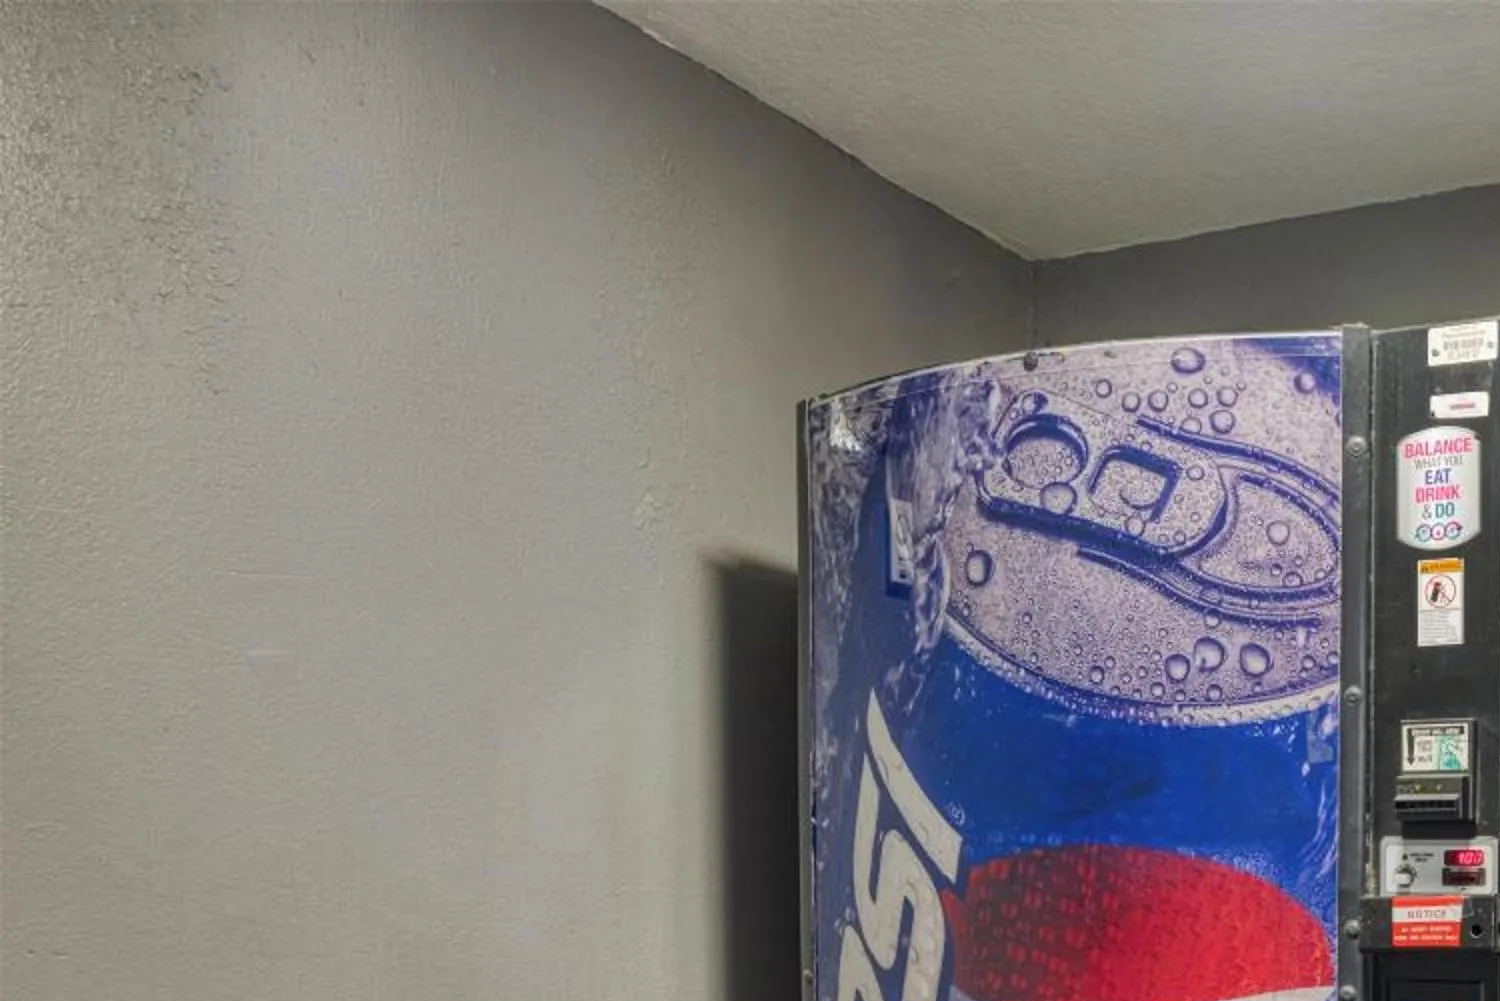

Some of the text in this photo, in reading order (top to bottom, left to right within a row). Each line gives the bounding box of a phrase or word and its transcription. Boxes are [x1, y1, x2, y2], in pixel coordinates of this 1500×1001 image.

[1405, 437, 1473, 458] BALANCE
[1424, 468, 1451, 485] EAT
[1415, 485, 1460, 503] DRINK
[1422, 502, 1455, 519] & DO
